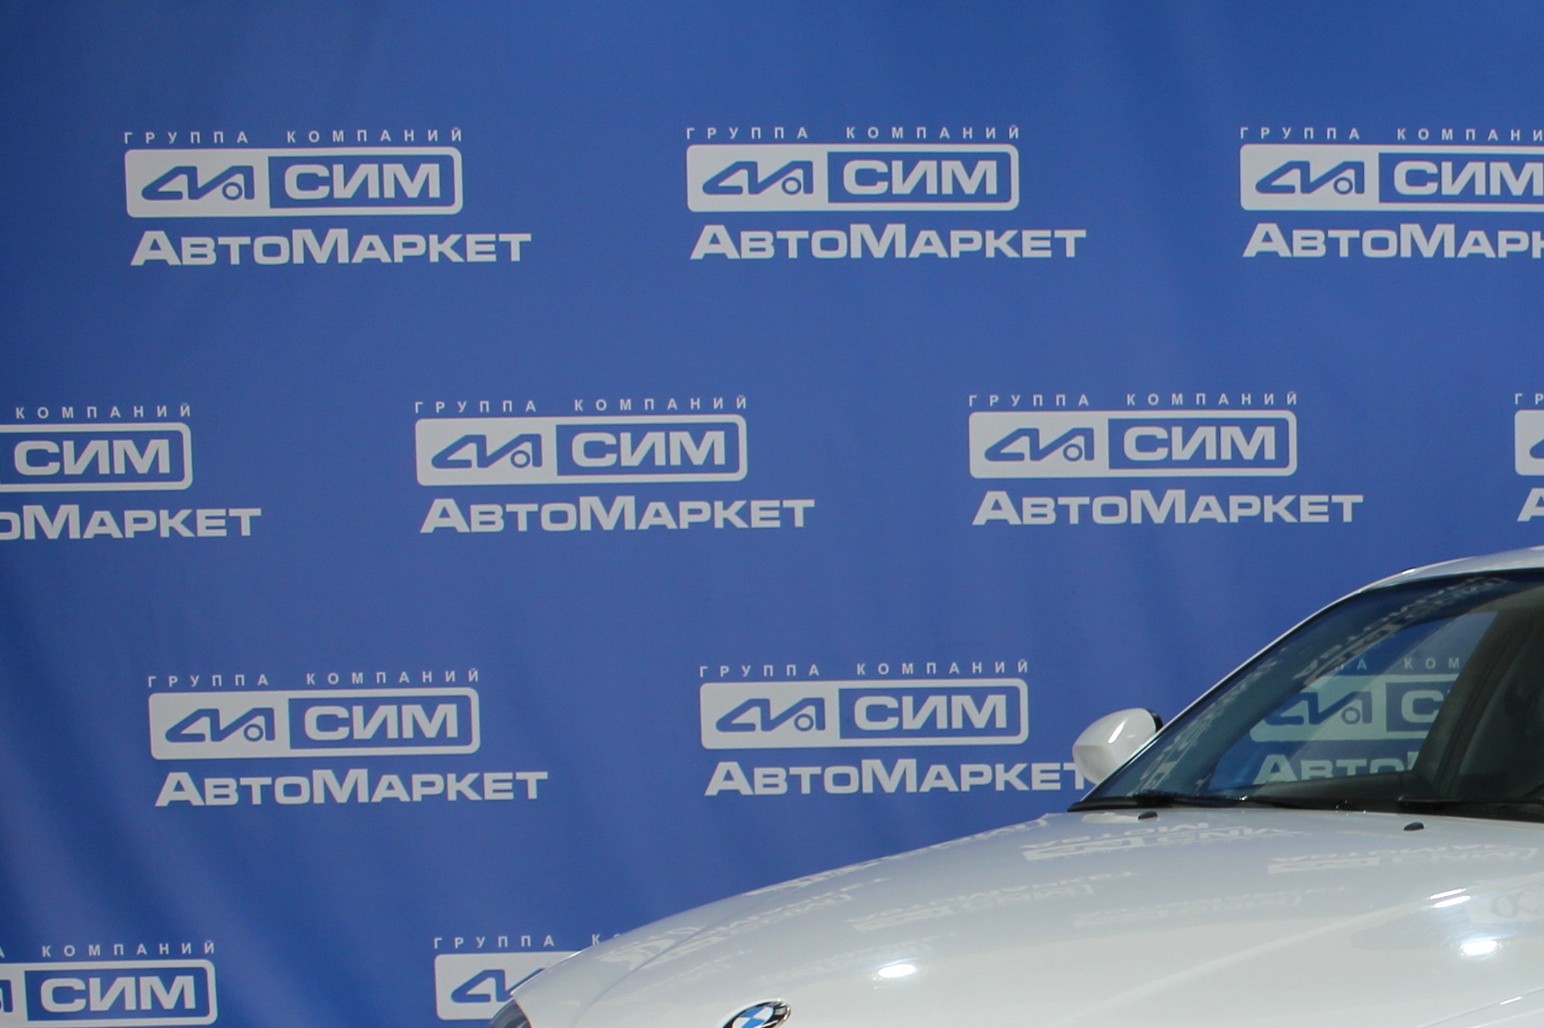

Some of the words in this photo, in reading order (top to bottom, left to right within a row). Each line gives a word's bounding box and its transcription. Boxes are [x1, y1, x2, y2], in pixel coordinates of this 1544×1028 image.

[125, 131, 248, 144] ГРУППА
[287, 128, 461, 142] КОМПАНИЙ
[687, 127, 807, 139] ГРУППА
[847, 126, 1018, 138] КОМПАНИЙ
[1241, 127, 1359, 139] ГРУППА
[285, 163, 440, 199] СИМ
[843, 160, 997, 194] СИМ
[1394, 161, 1544, 195] СИМ
[415, 400, 536, 413] ГРУППА
[575, 395, 746, 411] КОМПАНИЙ
[969, 394, 1088, 406] ГРУППА
[1127, 392, 1296, 405] КОМПАНИЙ
[16, 403, 190, 418] КОМПАНИЙ
[572, 431, 725, 466] СИМ
[1124, 426, 1275, 460] СИМ
[14, 439, 170, 475] СИМ
[148, 674, 268, 687] ГРУППА
[307, 668, 478, 684] КОМПАНИЙ
[700, 664, 819, 677] ГРУППА
[857, 660, 1027, 675] КОМПАНИЙ
[854, 694, 1006, 730] СИМ
[304, 704, 457, 740] СИМ
[42, 940, 214, 957] КОМПАНИЙ
[434, 935, 554, 948] ГРУППА
[41, 976, 195, 1012] СИМ
